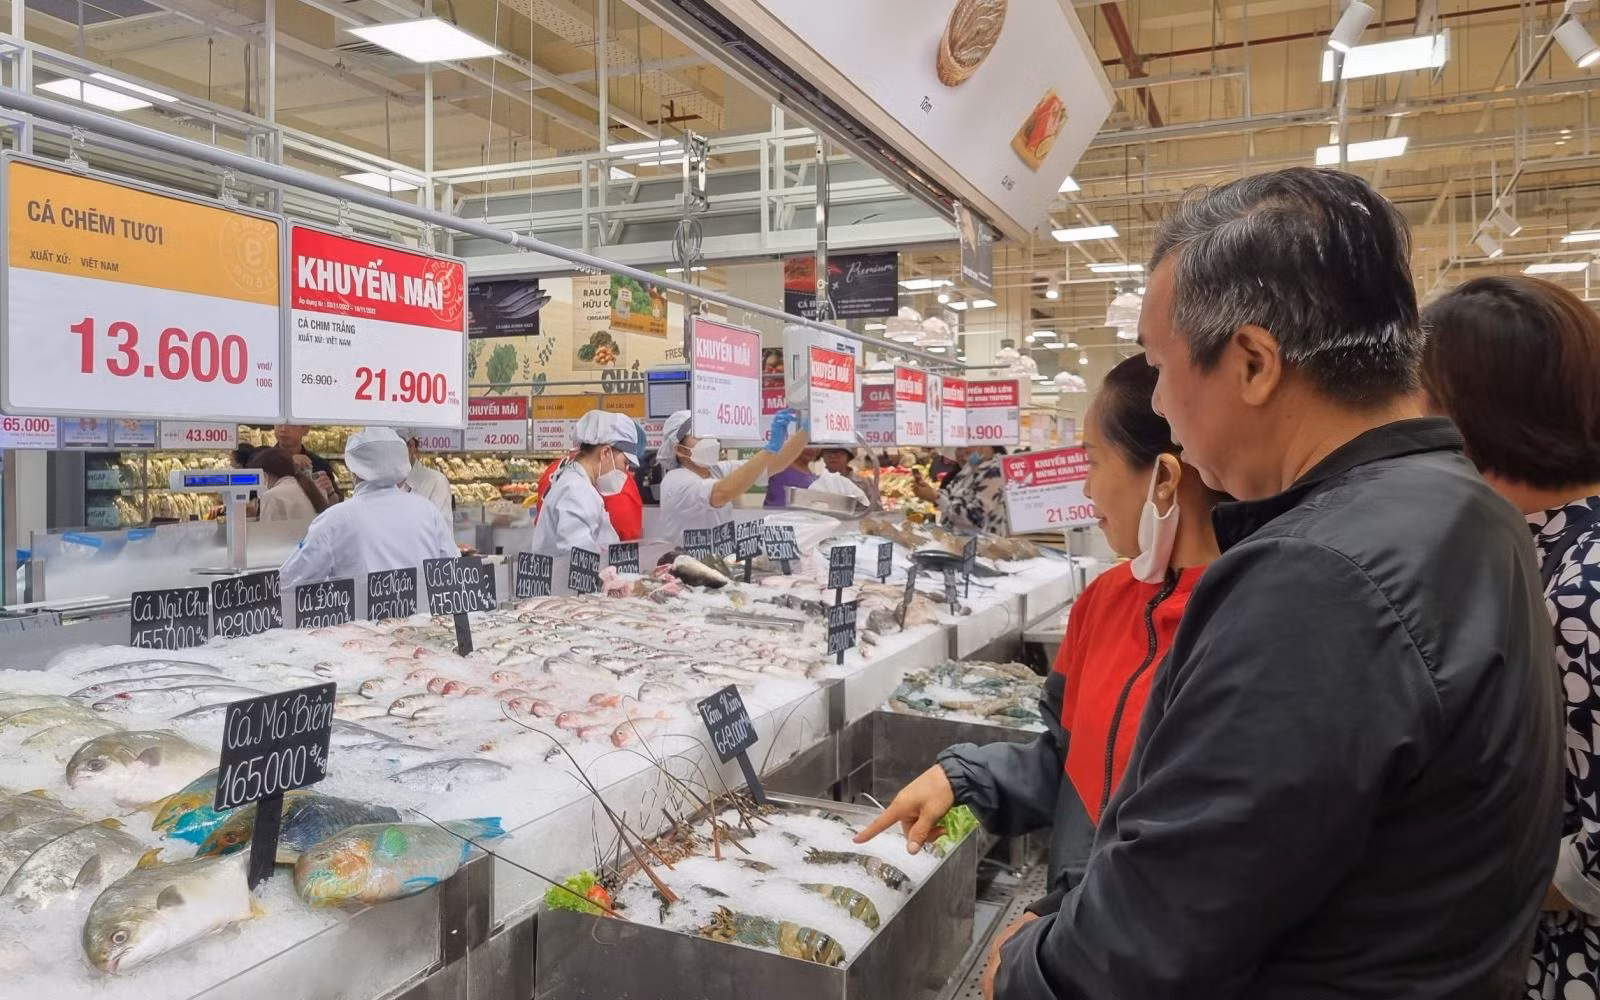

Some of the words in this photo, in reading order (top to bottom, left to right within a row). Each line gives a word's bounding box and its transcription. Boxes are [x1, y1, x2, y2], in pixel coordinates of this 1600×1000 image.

[27, 199, 55, 225] CÁ
[120, 219, 164, 245] TƯƠI
[30, 249, 53, 263] XUẤT
[100, 260, 119, 272] NAM
[298, 255, 397, 303] KHUYẾN
[403, 272, 443, 310] MÃI
[845, 261, 894, 284] Premium
[582, 299, 601, 309] HỮU
[583, 289, 601, 297] RAU
[298, 318, 309, 329] CÁ
[310, 320, 330, 332] CHIM
[70, 316, 248, 384] 13.600
[696, 336, 733, 363] KHUYẾN
[734, 343, 750, 367] MÃI
[257, 360, 273, 372] vnd/
[811, 359, 836, 381] KHUYẾN
[255, 377, 273, 389] 100G
[301, 373, 332, 385] 26.900
[354, 366, 447, 404] 21.900
[869, 389, 891, 401] GIÁ
[467, 402, 500, 417] KHUYẾN
[502, 404, 518, 416] MÃI
[716, 402, 753, 426] 45.000
[3, 417, 50, 432] 65.000
[185, 429, 228, 442] 43.900
[484, 433, 520, 446] 42.000
[865, 431, 895, 443] 59.00
[1046, 503, 1096, 523] 21.500
[369, 574, 383, 598] Cá
[427, 559, 444, 587] Cá
[443, 558, 480, 592] Ngao
[214, 582, 232, 610] Cá
[298, 586, 313, 613] Cá
[133, 594, 153, 622] Cá
[228, 702, 255, 750] Cá
[254, 696, 291, 745] Mó
[699, 702, 723, 726] Tôm
[217, 744, 307, 811] 165.000
